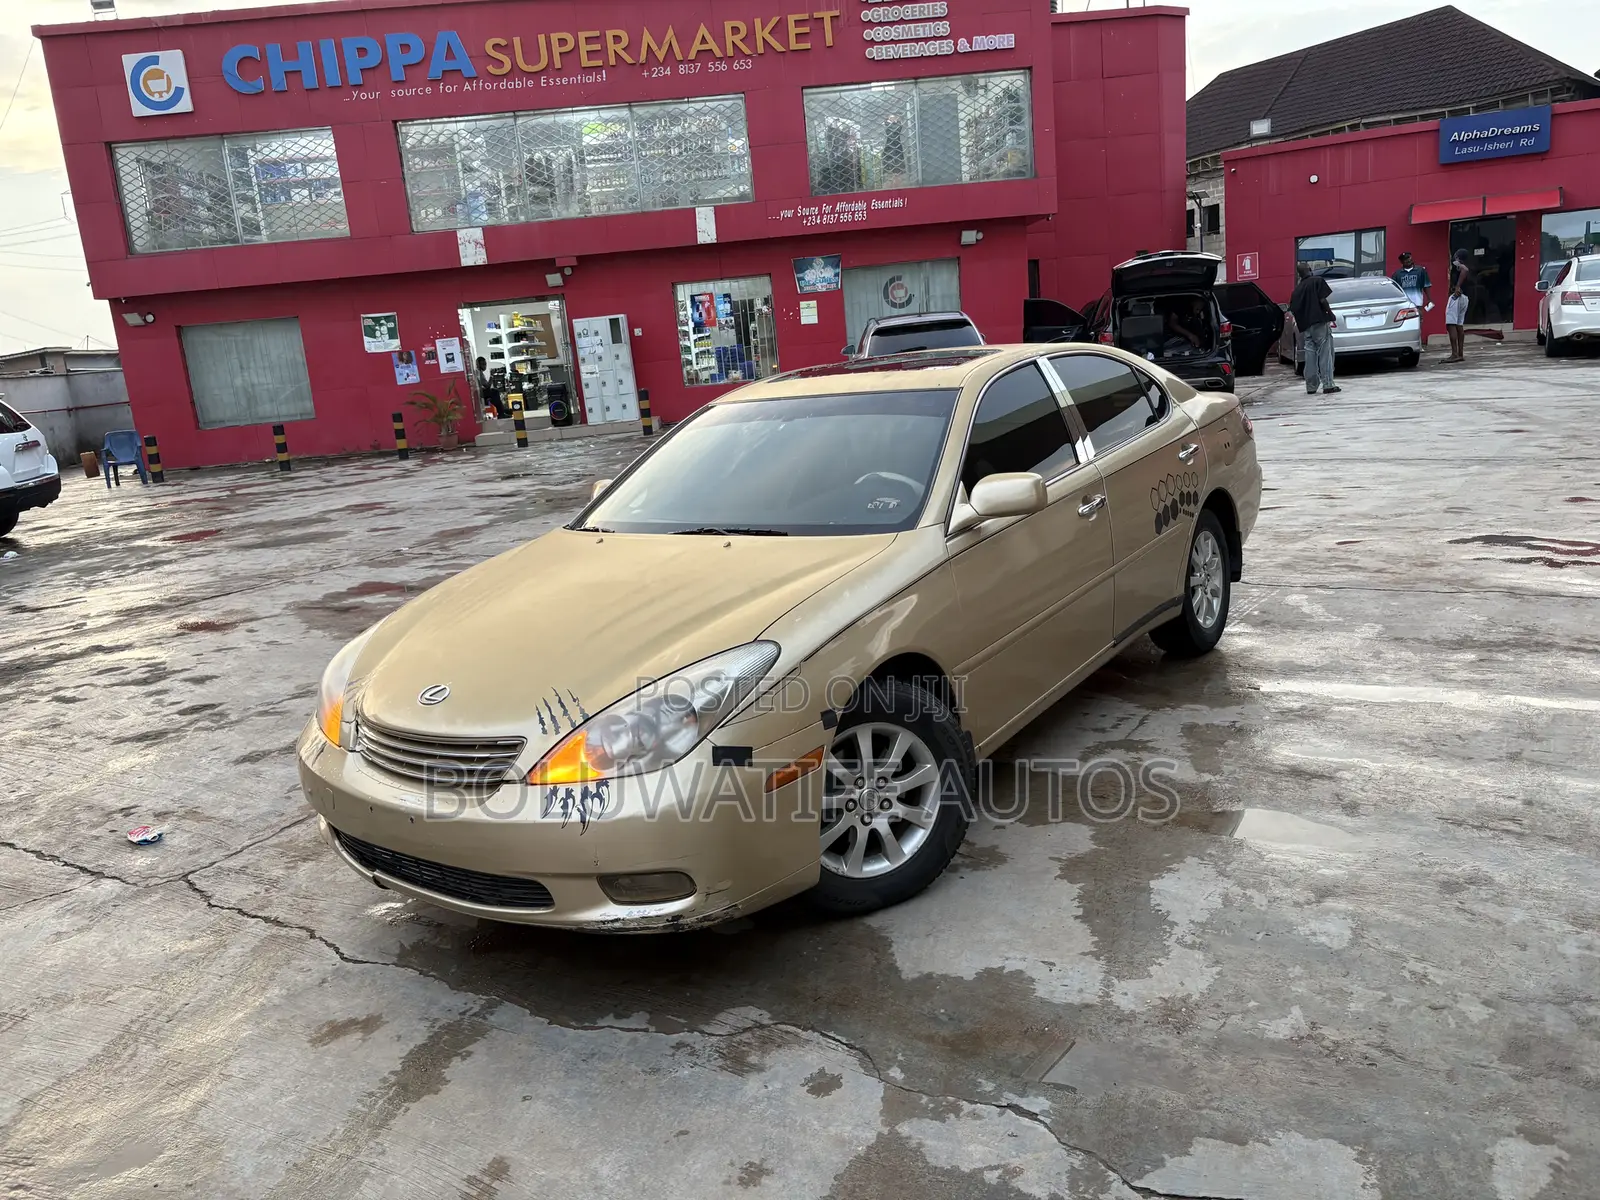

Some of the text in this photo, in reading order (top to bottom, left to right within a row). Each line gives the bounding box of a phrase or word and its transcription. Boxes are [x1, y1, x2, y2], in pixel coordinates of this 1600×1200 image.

[870, 3, 948, 22] GROCERIES
[873, 22, 950, 41] COSMETICS
[221, 10, 840, 94] CHIPPA SUPERMARKET
[874, 34, 1015, 60] BEVERAGES & MORE
[641, 59, 752, 79] +234 8137 556 653
[390, 87, 432, 98] source
[439, 83, 458, 94] for
[463, 77, 534, 92] Affordable
[540, 70, 607, 87] Essentials!
[1450, 123, 1540, 142] AlphaDreams
[1455, 137, 1535, 155] Lasu-Isheri Rd
[797, 205, 819, 217] Source
[822, 203, 832, 214] For
[835, 200, 867, 213] Affordable
[803, 215, 821, 226] +234
[822, 213, 838, 225] 8137
